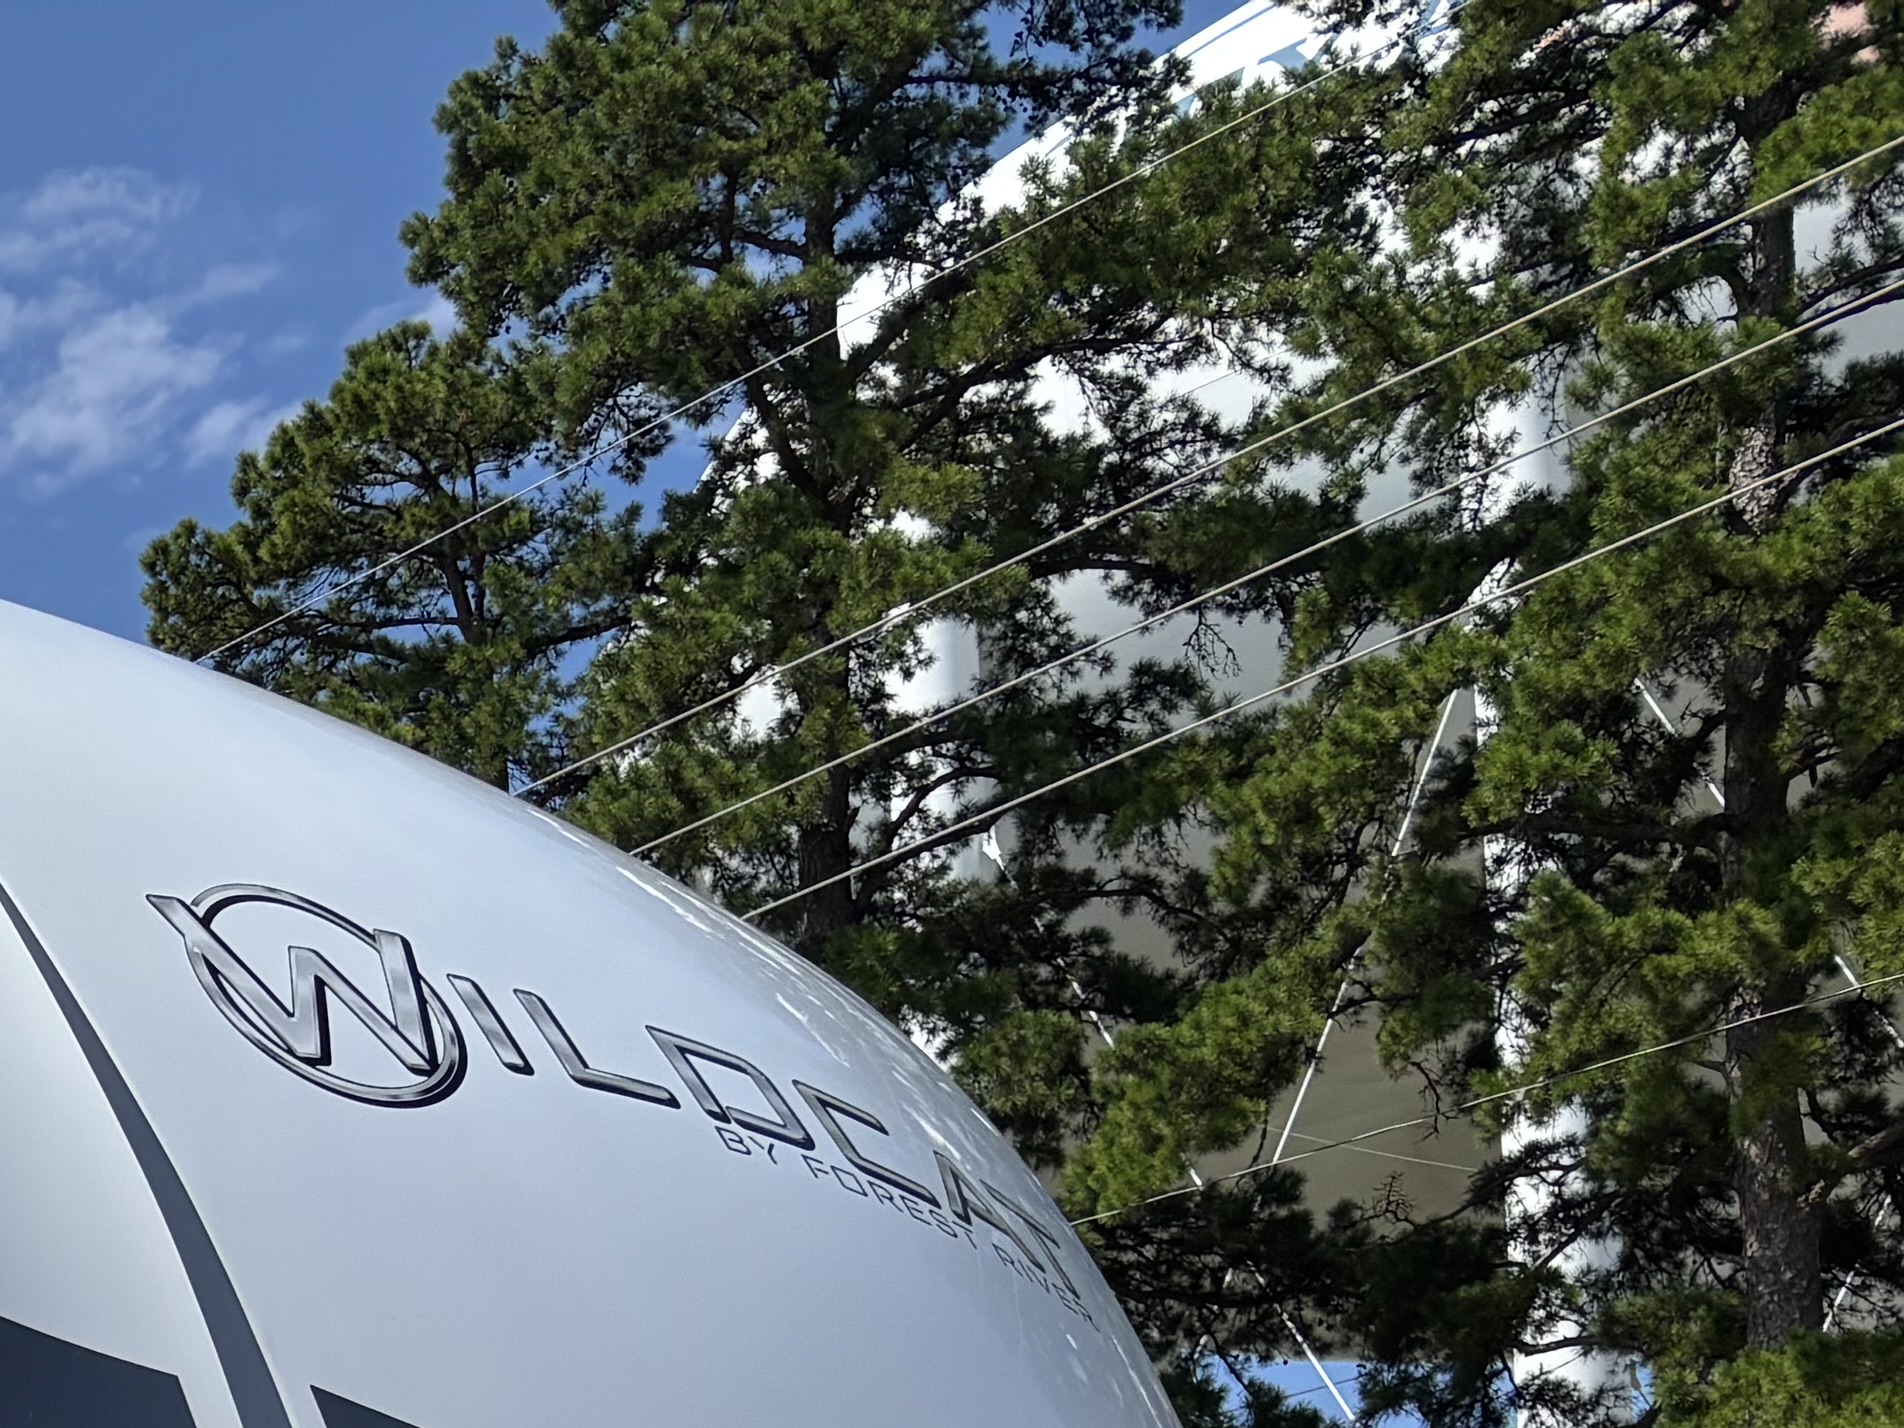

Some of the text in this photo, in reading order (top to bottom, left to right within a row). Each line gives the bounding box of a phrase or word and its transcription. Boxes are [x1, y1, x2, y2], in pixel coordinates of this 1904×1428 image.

[145, 883, 1081, 1300] WILDCAT
[714, 1125, 1099, 1332] BY FOREST RIVER
